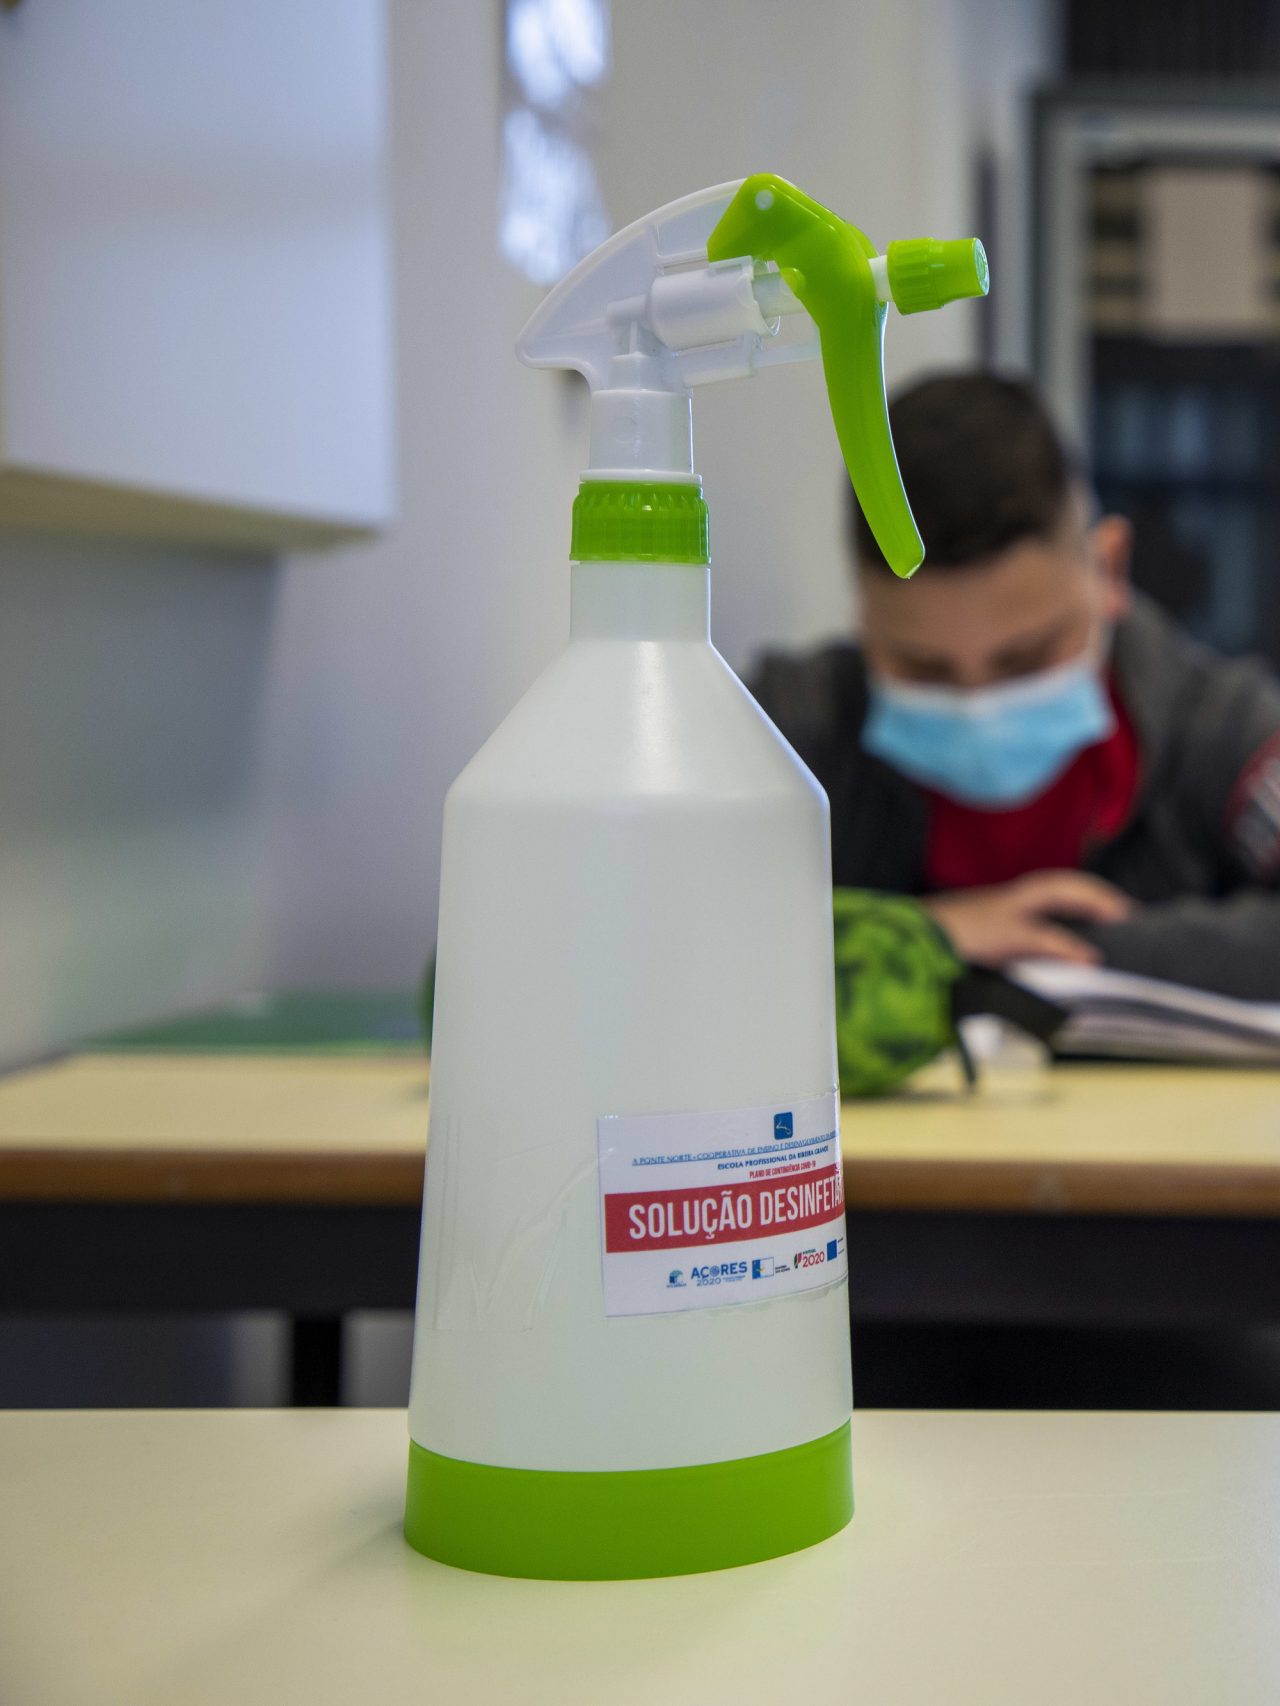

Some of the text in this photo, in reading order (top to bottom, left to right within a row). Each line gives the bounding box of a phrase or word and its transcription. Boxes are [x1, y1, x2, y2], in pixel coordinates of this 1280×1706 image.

[717, 1161, 743, 1170] ESCOLA
[745, 1156, 787, 1167] PROFISSIONAL
[788, 1153, 797, 1161] DA
[749, 1169, 765, 1179] PLANO
[628, 1189, 752, 1240] SOLUÇÃO
[802, 1251, 825, 1268] 2020
[696, 1277, 722, 1287] 2020
